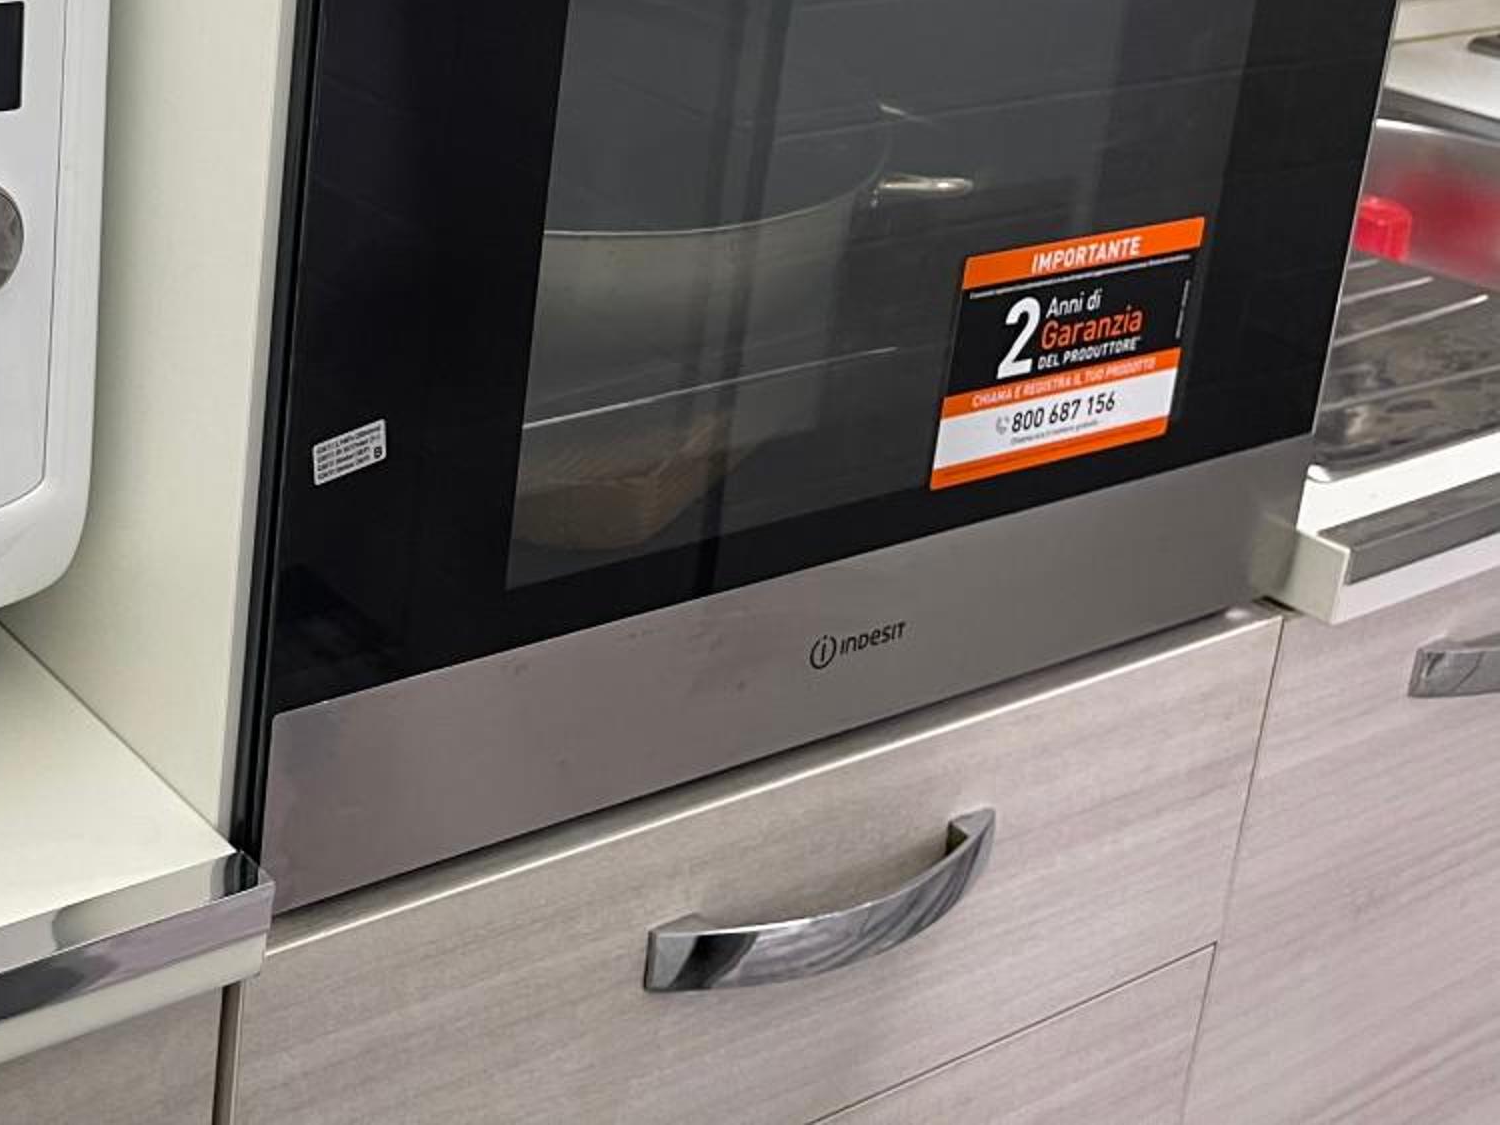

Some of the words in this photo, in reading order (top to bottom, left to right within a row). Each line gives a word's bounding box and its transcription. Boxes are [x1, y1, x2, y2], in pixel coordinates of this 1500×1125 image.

[1031, 235, 1142, 275] IMPORTANTE
[1046, 290, 1086, 319] Anni
[1086, 288, 1103, 311] di
[996, 296, 1041, 379] 2
[1041, 305, 1143, 349] Garanzia
[1037, 352, 1060, 370] DEL
[1011, 408, 1044, 433] 800
[1050, 400, 1081, 424] 687
[1086, 391, 1116, 415] 156
